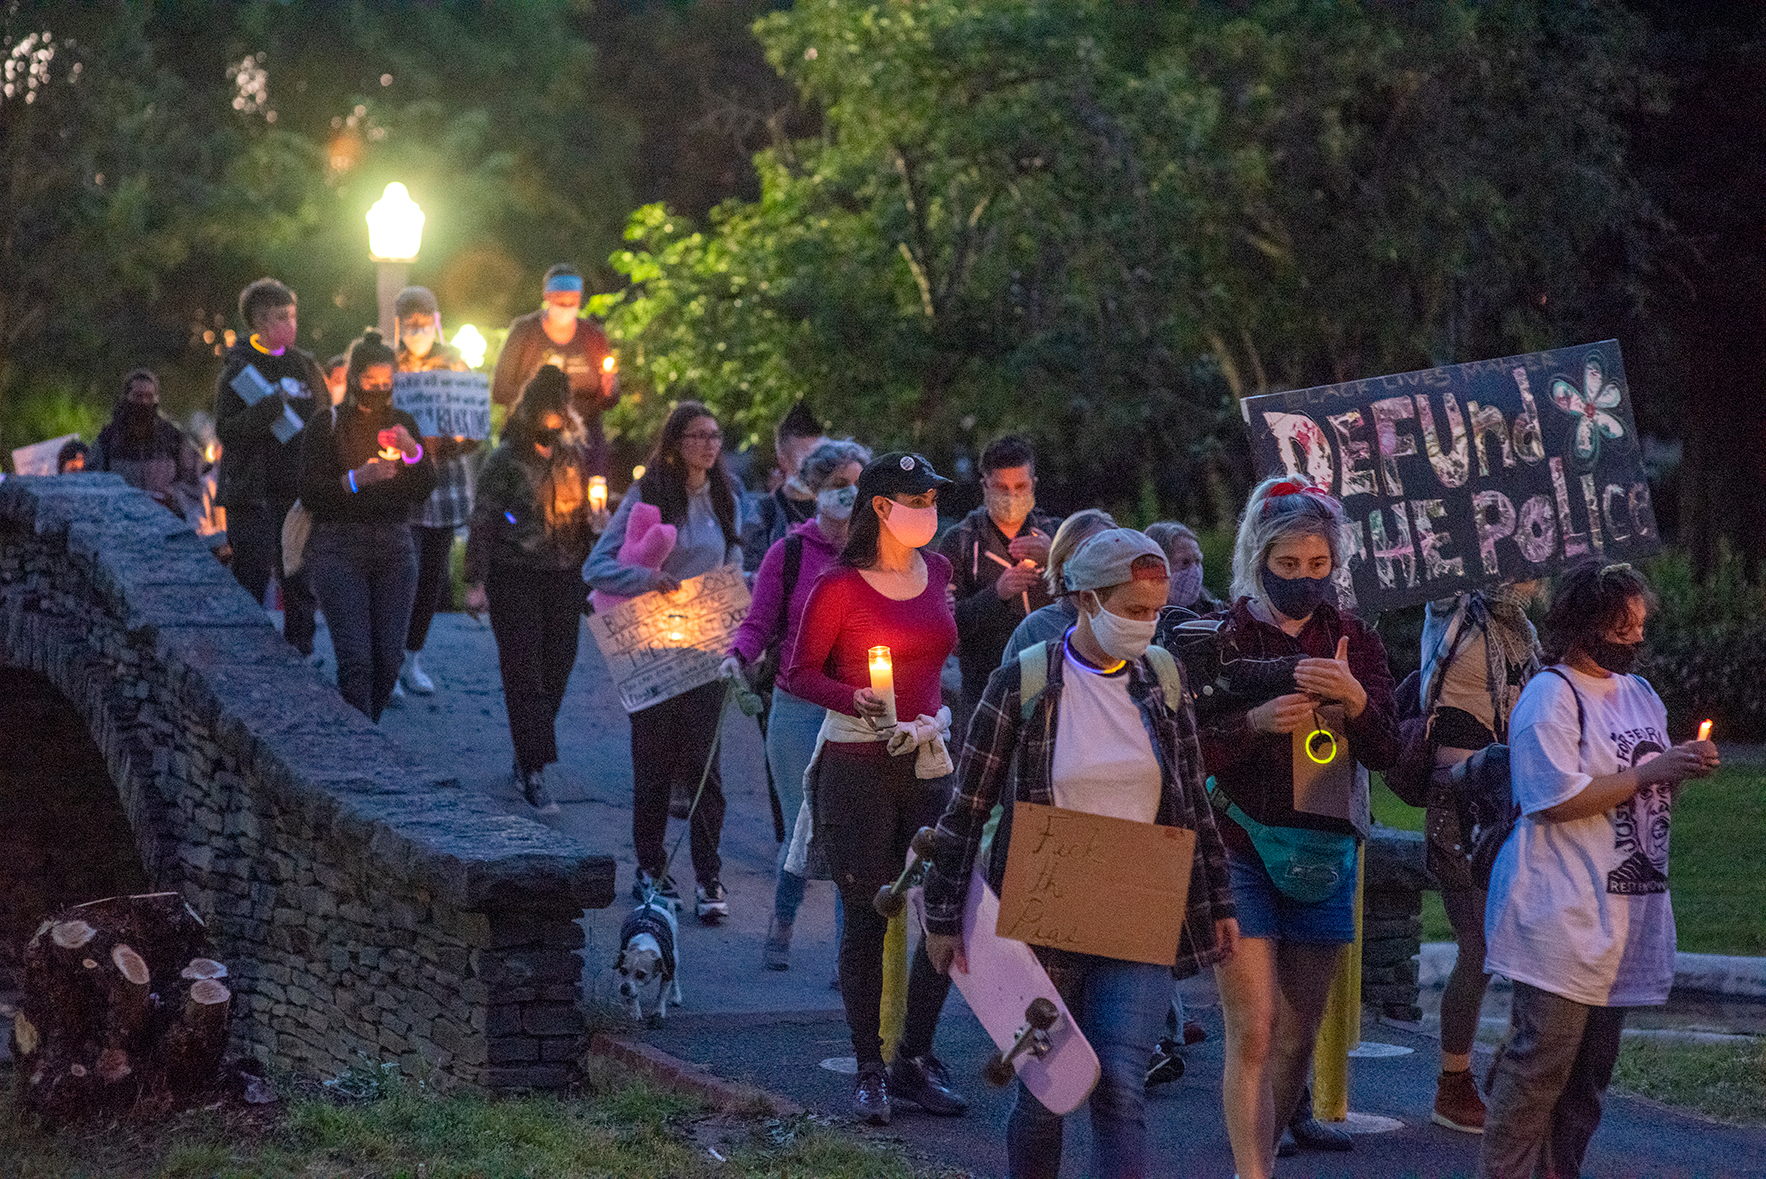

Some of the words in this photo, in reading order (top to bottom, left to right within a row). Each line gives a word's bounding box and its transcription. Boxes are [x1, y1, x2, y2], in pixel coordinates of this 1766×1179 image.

[1382, 367, 1450, 390] LIVES
[1616, 733, 1634, 761] FOR
[1032, 815, 1104, 865] Fuck
